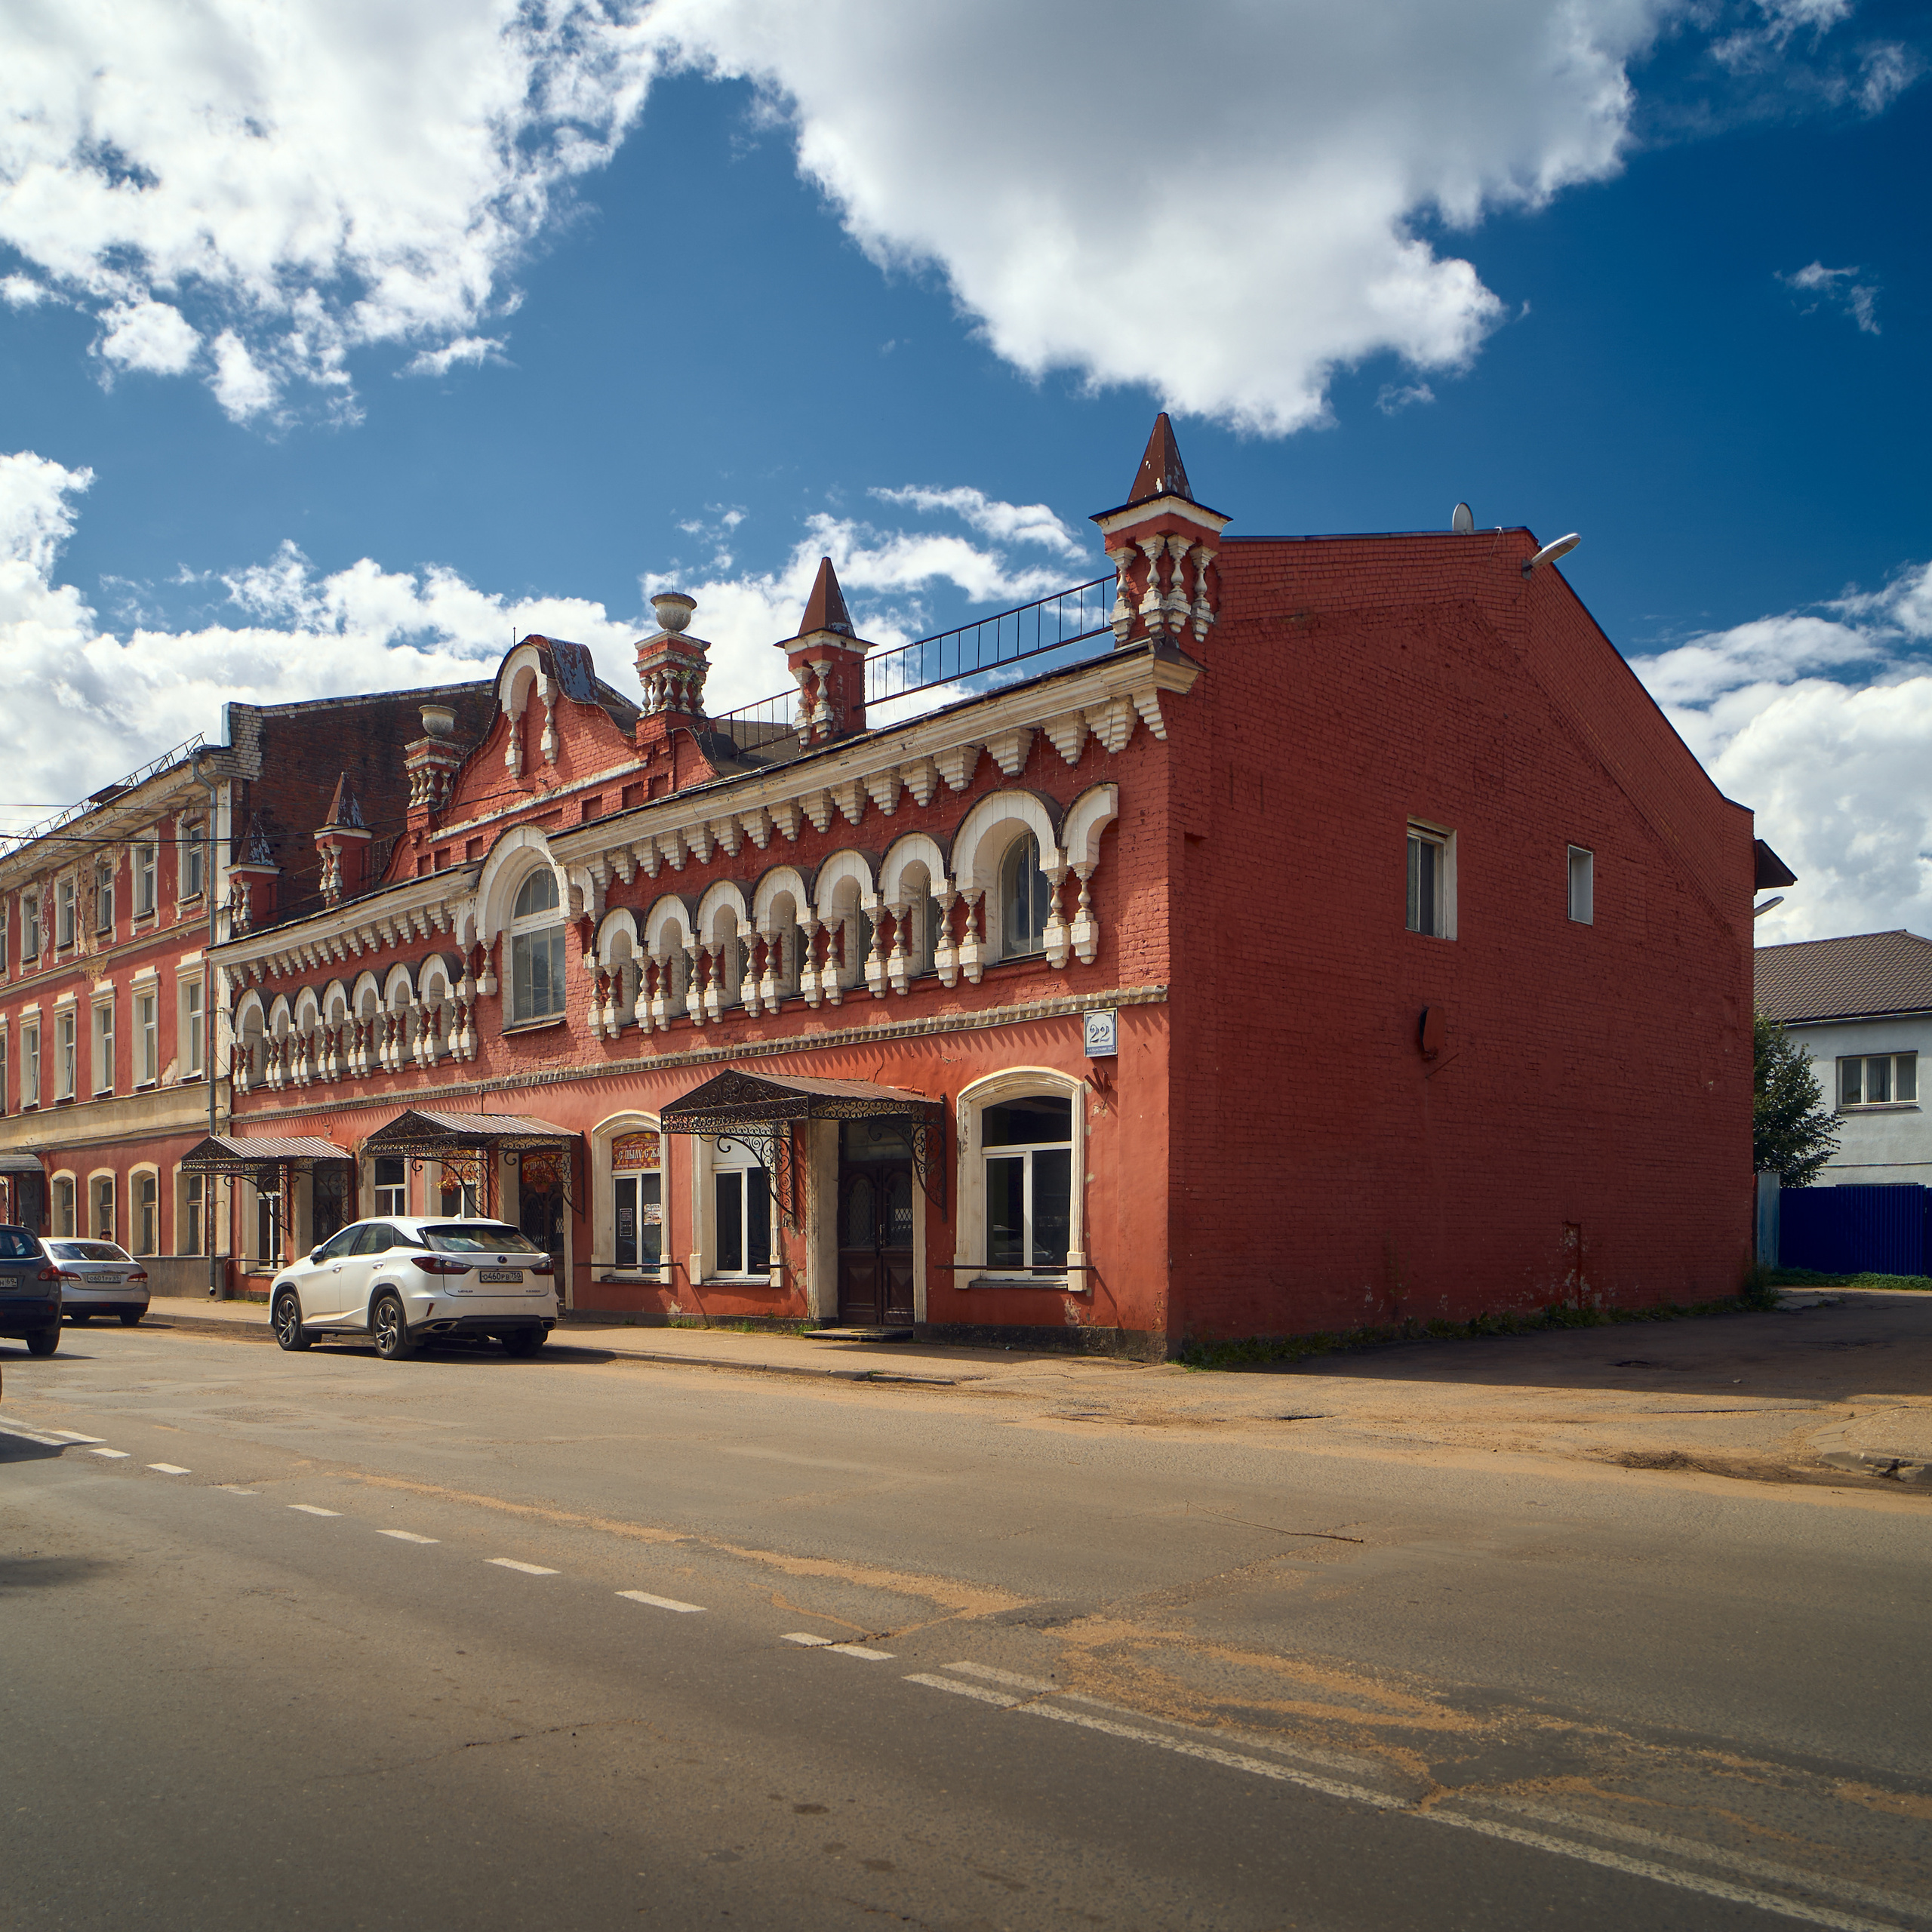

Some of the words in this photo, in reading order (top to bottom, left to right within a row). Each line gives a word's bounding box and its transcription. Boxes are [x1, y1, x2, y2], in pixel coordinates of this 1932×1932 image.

[1090, 1023, 1110, 1043] 22
[619, 1151, 623, 1160] С
[625, 1149, 643, 1161] ПЫЛУ
[644, 1149, 649, 1158] С
